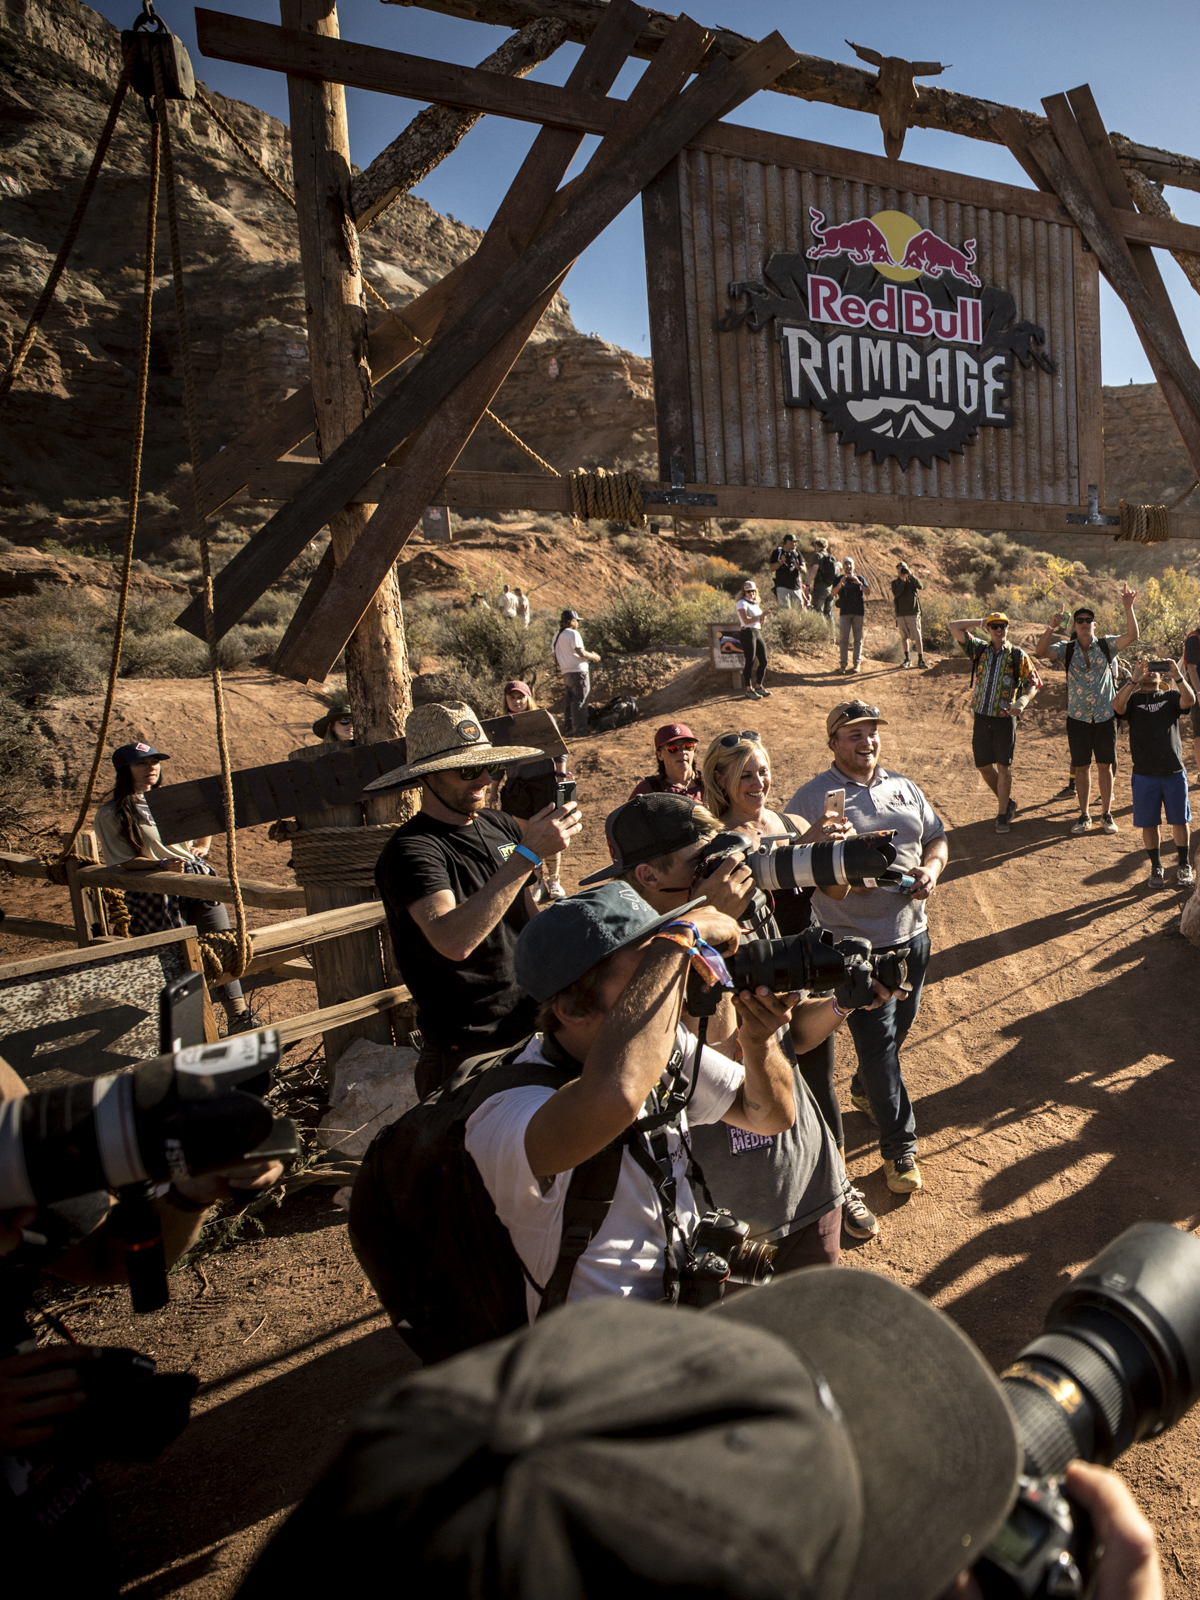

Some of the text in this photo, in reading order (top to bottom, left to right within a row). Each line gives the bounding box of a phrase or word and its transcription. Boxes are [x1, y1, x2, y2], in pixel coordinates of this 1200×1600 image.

[807, 273, 983, 345] Red Bull
[782, 326, 1008, 420] RAMPAGE
[732, 1134, 773, 1150] MEDIA
